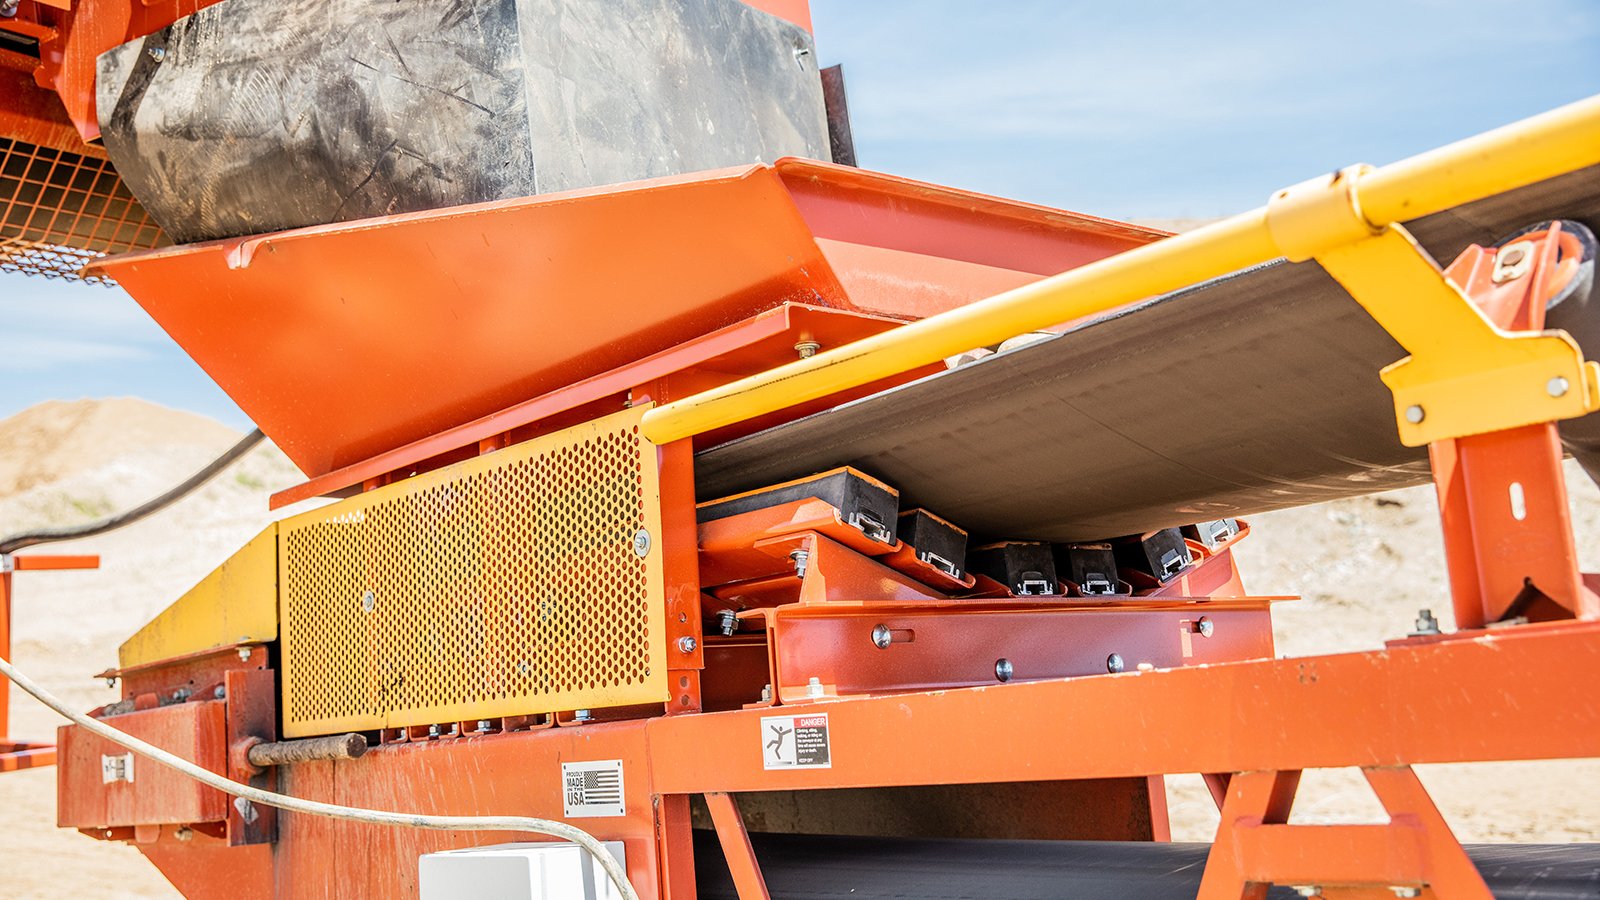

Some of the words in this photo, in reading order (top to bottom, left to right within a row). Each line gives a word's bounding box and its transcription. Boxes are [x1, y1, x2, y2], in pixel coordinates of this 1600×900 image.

[801, 718, 825, 726] DANGER
[566, 777, 583, 787] MADE
[567, 792, 585, 806] USA
